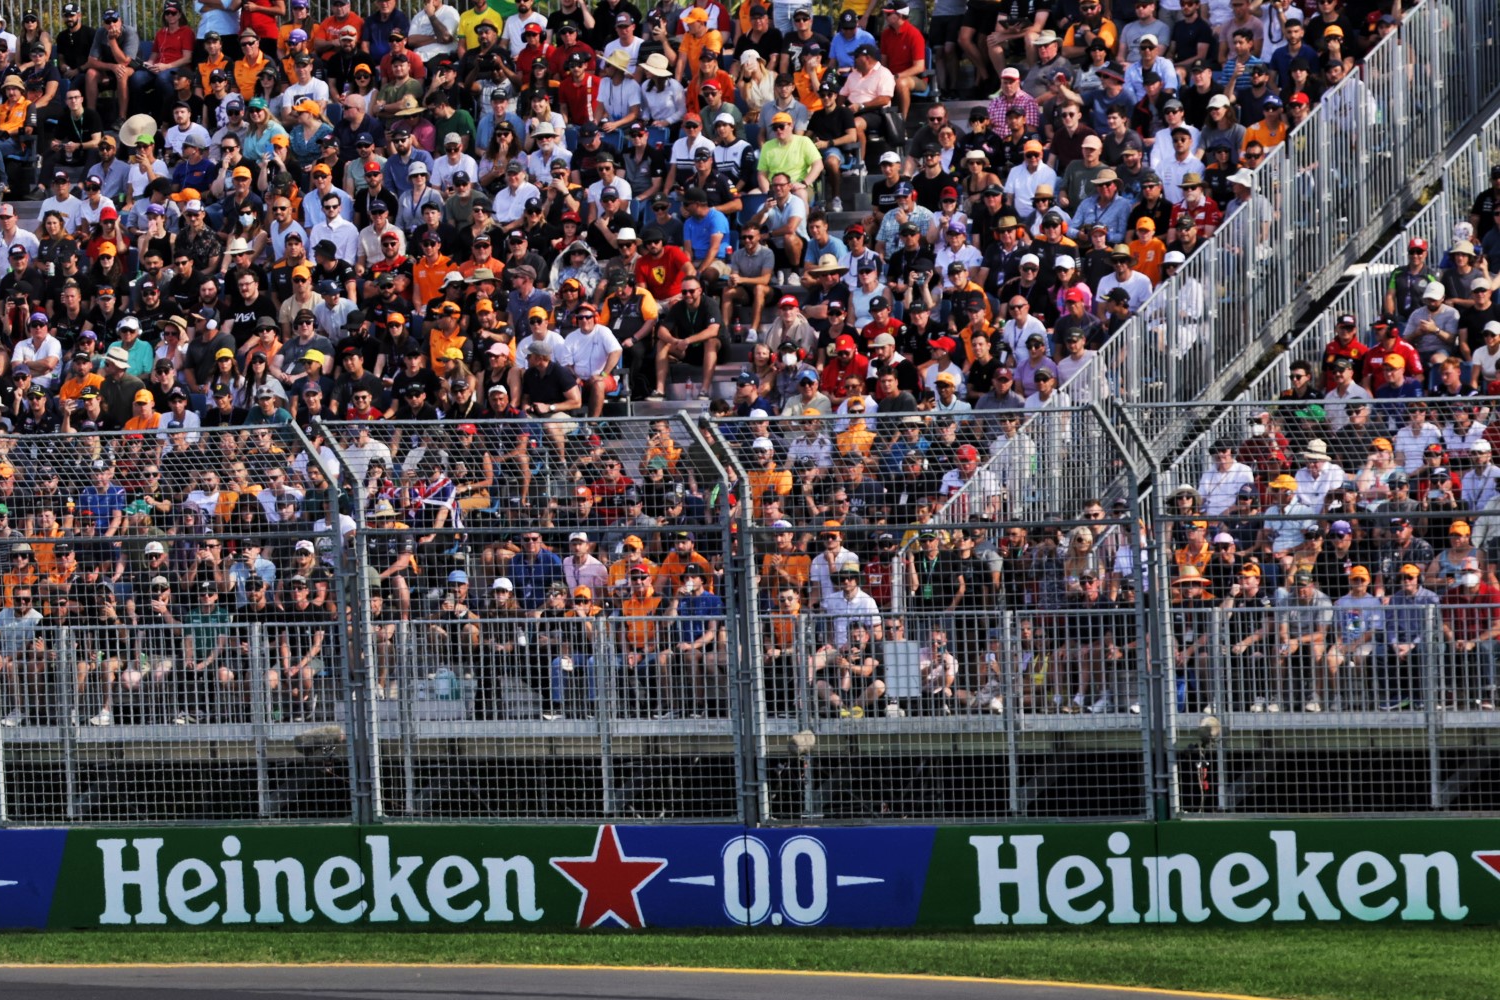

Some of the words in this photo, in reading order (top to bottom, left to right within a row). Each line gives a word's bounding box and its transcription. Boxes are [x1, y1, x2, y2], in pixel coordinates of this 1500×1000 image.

[96, 835, 544, 925] Heineken
[721, 835, 830, 926] 0.0
[969, 830, 1468, 925] Heineken
